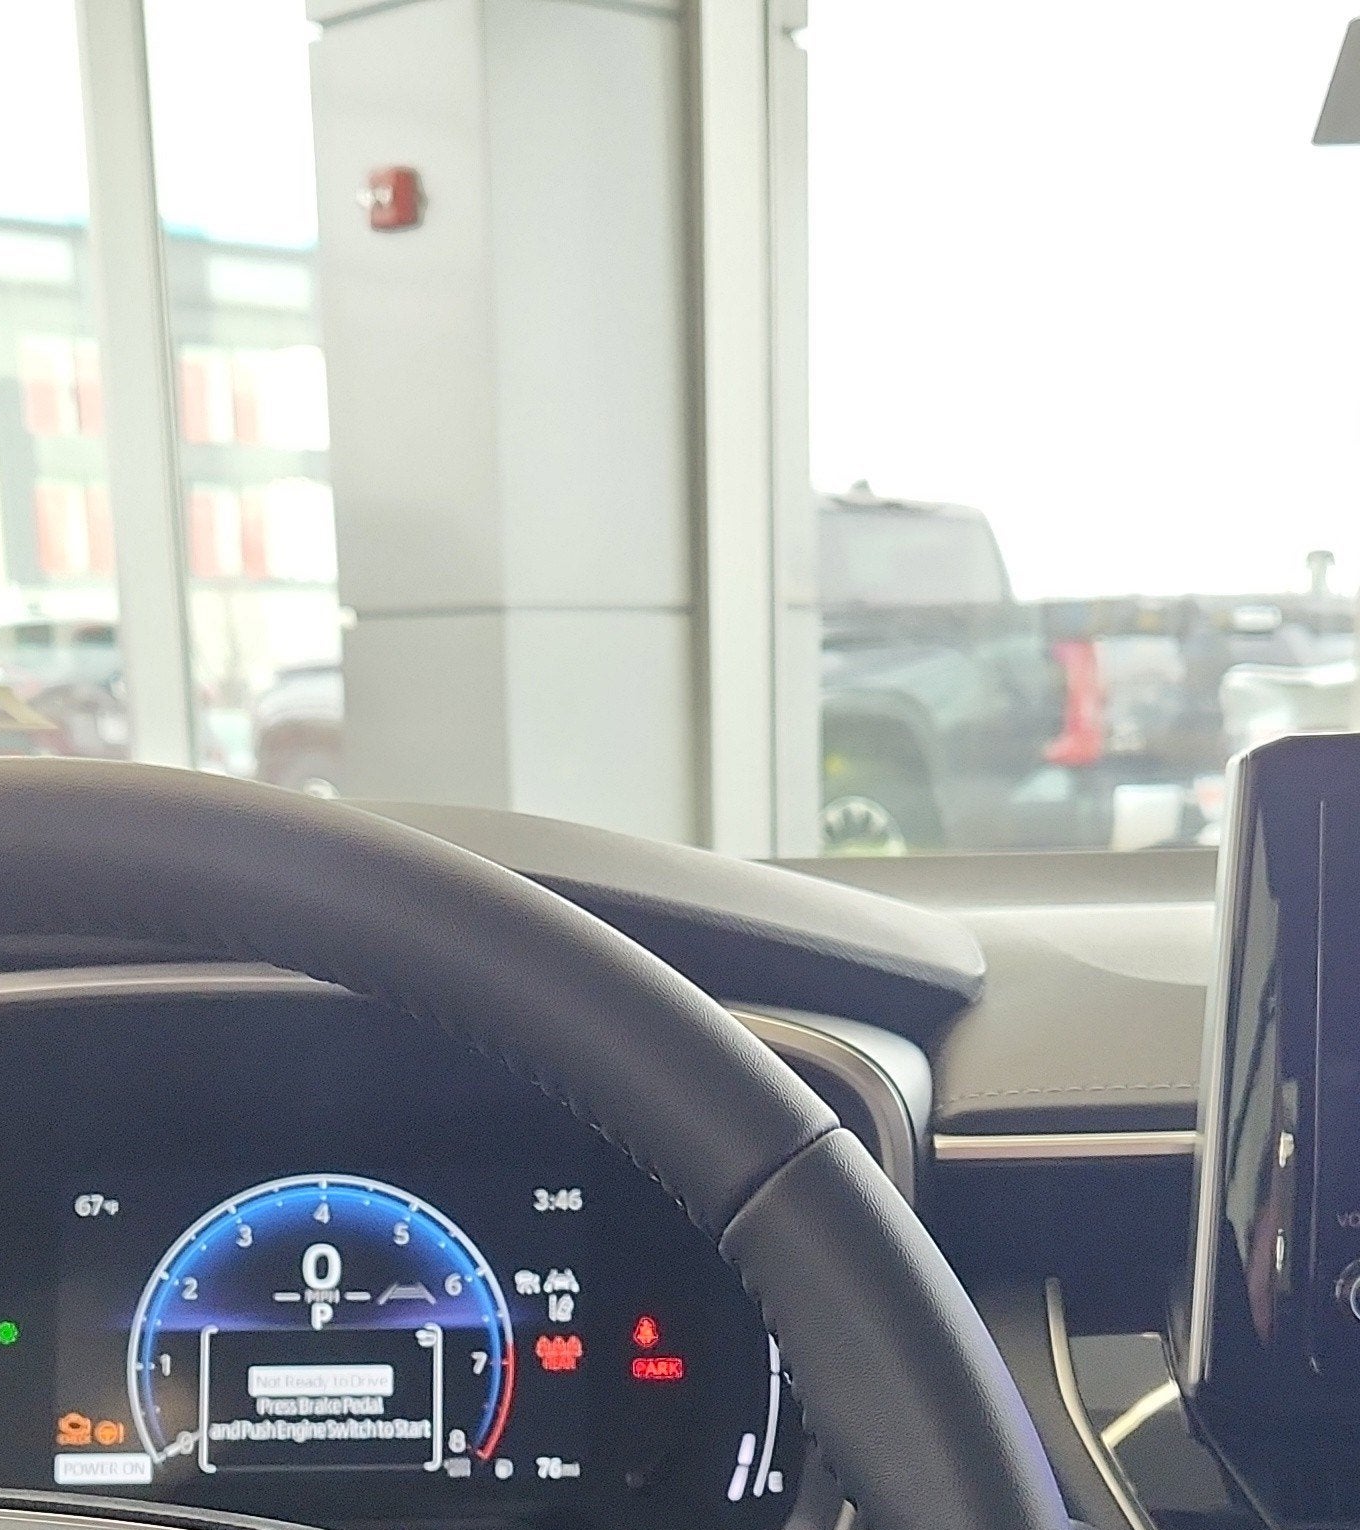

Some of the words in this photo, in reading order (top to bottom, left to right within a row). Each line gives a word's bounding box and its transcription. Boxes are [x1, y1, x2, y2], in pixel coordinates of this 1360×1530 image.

[533, 1188, 583, 1211] 3:46
[313, 1202, 330, 1224] 4
[236, 1225, 253, 1248] 3
[393, 1222, 409, 1245] 5
[302, 1243, 341, 1290] 0
[181, 1276, 198, 1300] 2
[444, 1273, 462, 1296] 6
[311, 1302, 333, 1330] P
[159, 1353, 171, 1377] 1
[471, 1351, 488, 1375] 7
[635, 1361, 680, 1377] PARK
[256, 1396, 297, 1415] Press
[298, 1396, 342, 1415] Brake
[343, 1395, 384, 1415] Pedal
[241, 1420, 276, 1440] Push
[277, 1418, 325, 1443] Engine
[326, 1418, 377, 1439] Switch
[394, 1418, 431, 1439] Start
[63, 1463, 123, 1476] POWER
[125, 1462, 145, 1475] ON
